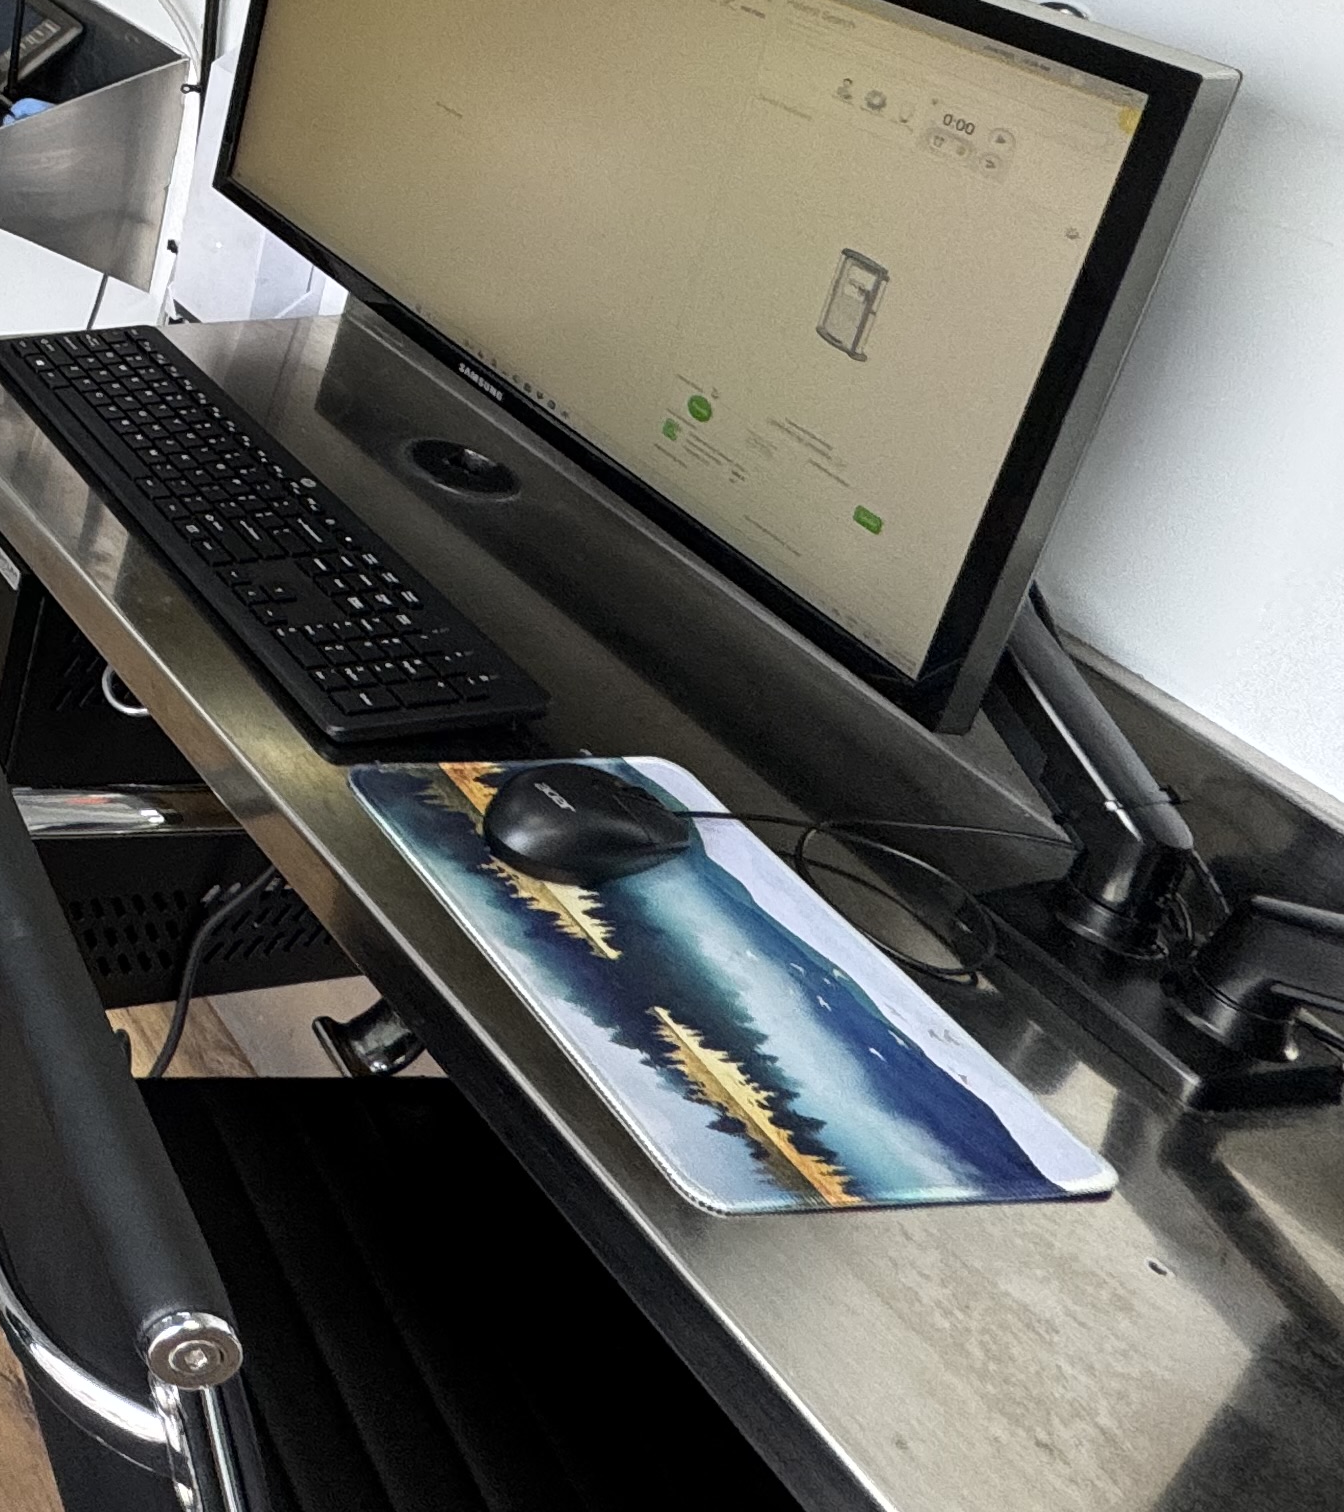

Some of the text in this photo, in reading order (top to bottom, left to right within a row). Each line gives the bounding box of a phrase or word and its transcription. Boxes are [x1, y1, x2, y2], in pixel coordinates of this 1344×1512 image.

[943, 113, 976, 135] 0:00
[458, 362, 503, 401] SAMSUNG
[534, 782, 577, 813] acer
